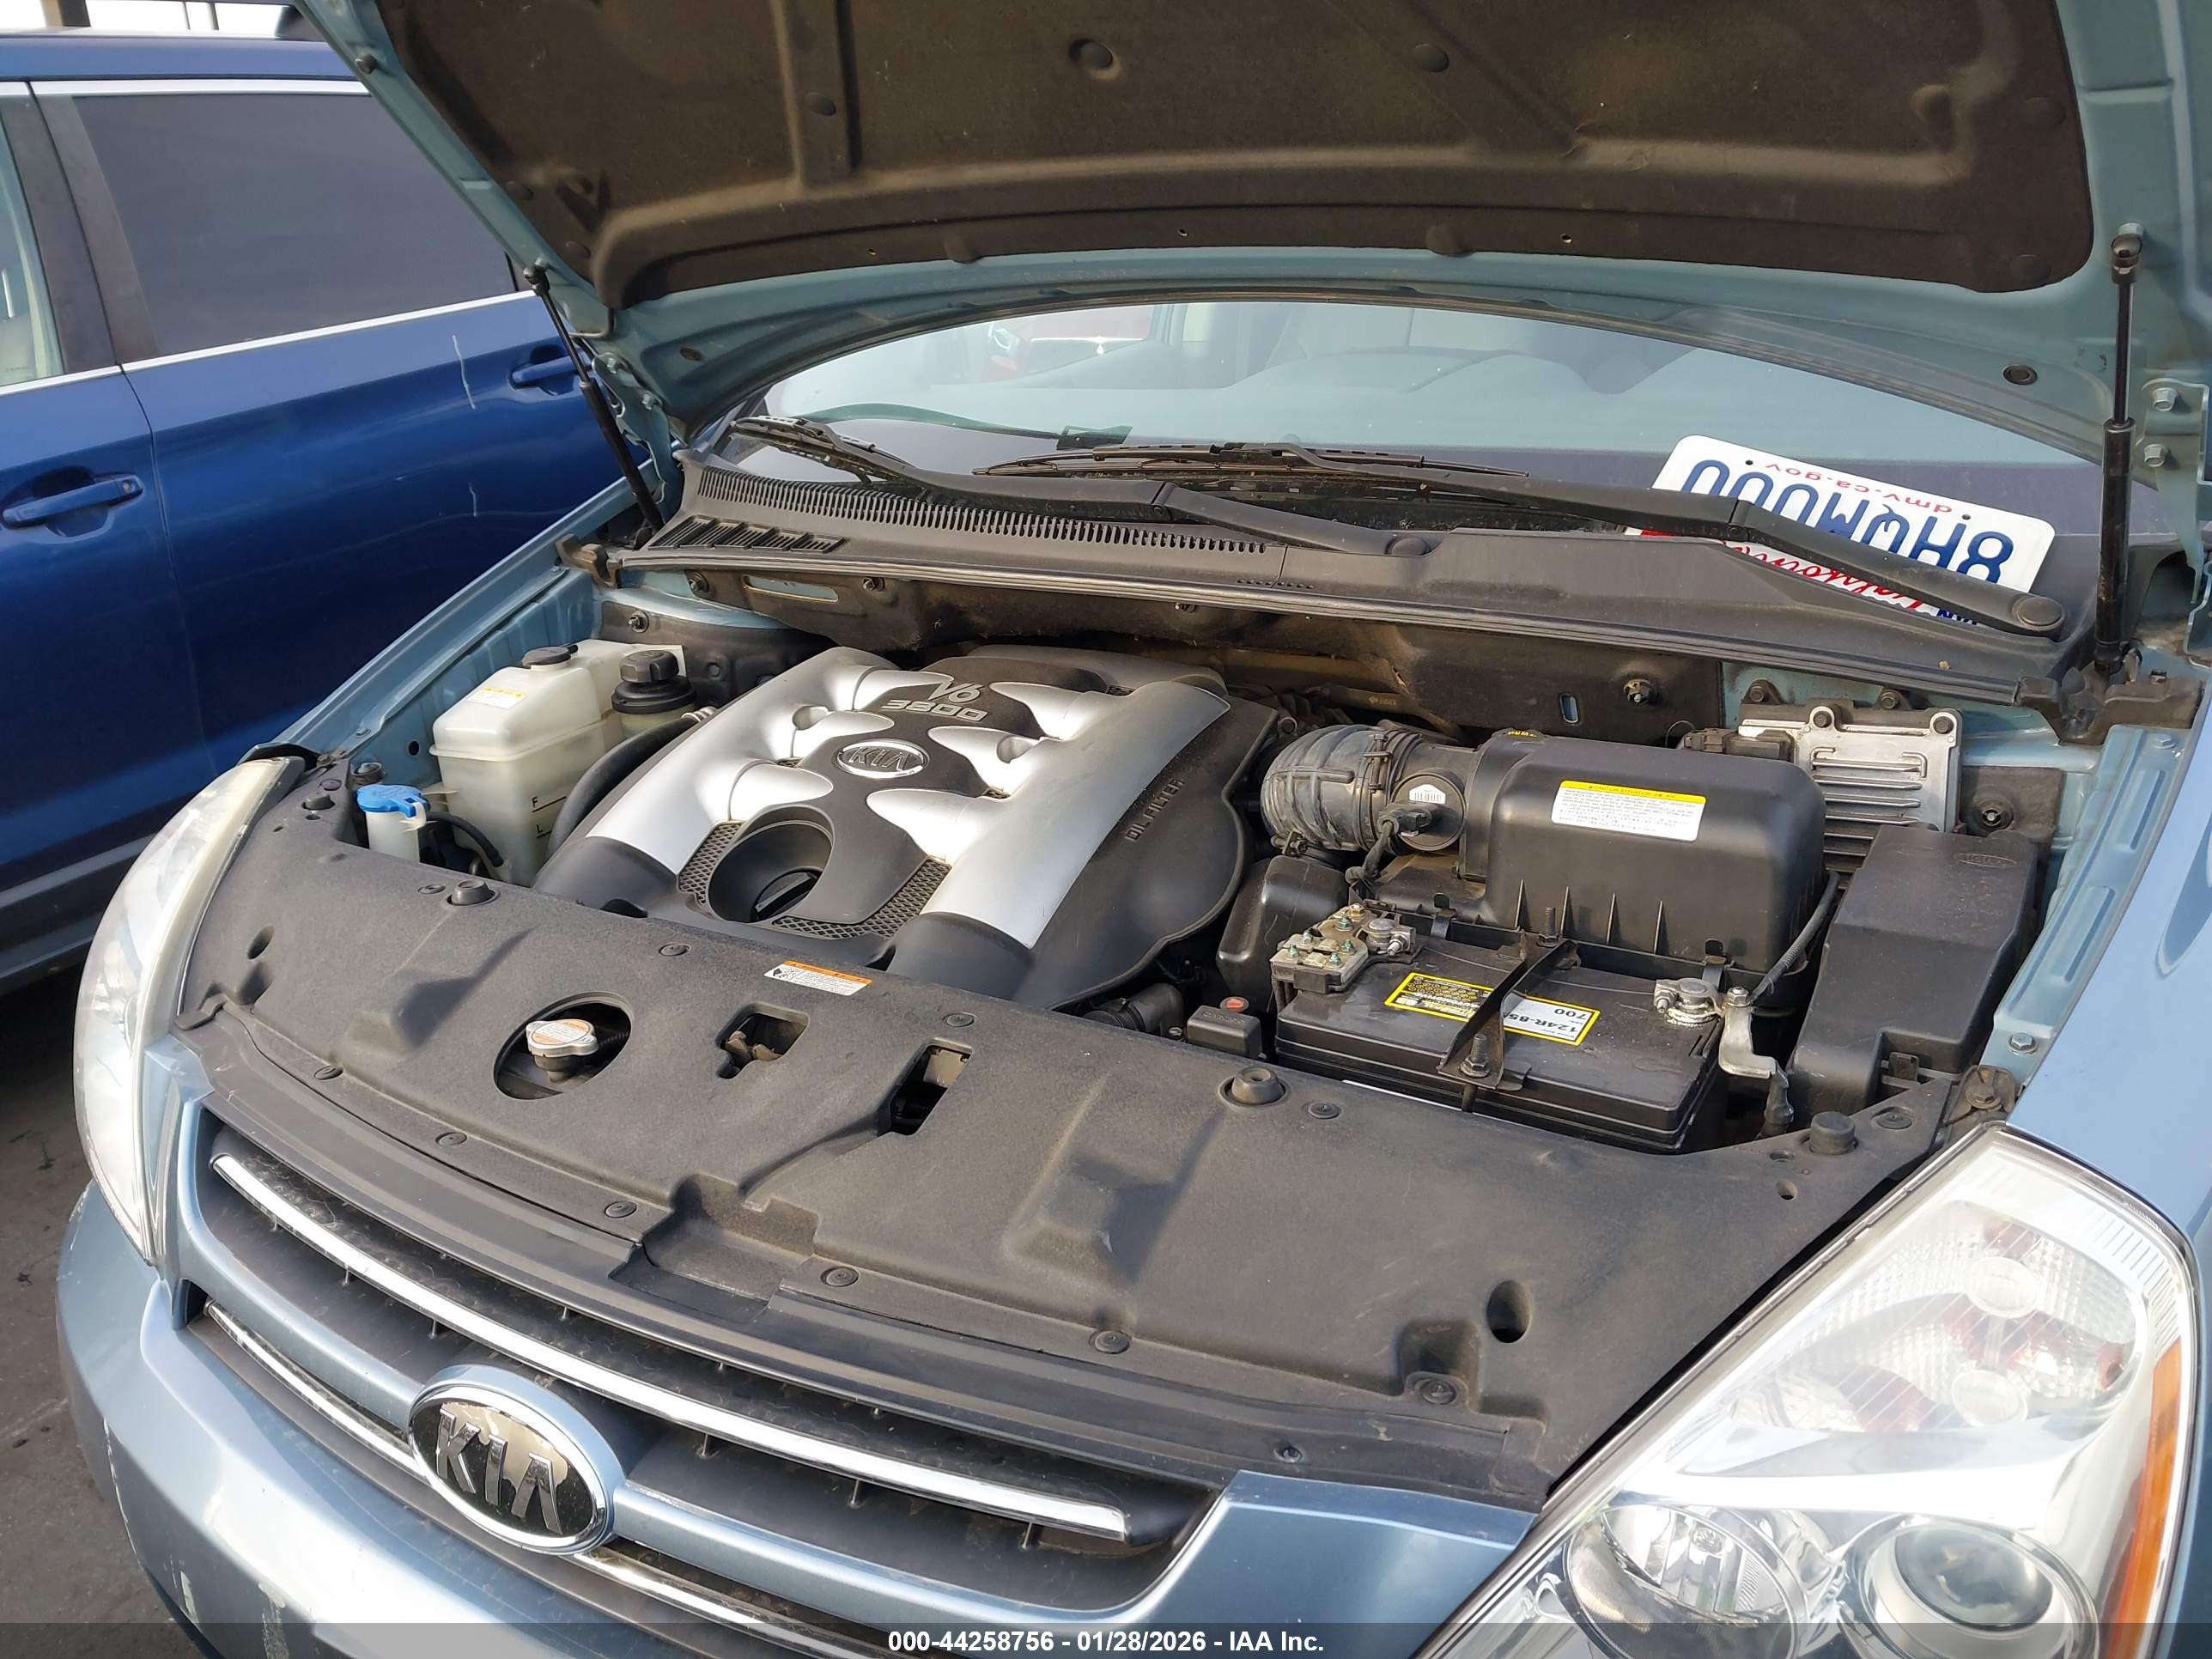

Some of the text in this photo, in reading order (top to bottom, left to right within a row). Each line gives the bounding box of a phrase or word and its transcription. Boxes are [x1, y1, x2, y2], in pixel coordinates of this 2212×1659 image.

[1765, 464, 1952, 513] dmv.ca.gov
[927, 681, 986, 702] V6
[881, 700, 988, 722] 3800
[848, 746, 910, 771] KIA
[532, 796, 538, 809] F
[1125, 779, 1185, 842] OIL FILTER
[537, 824, 544, 833] L
[1554, 1008, 1587, 1020] 700
[436, 1408, 562, 1534] KIA
